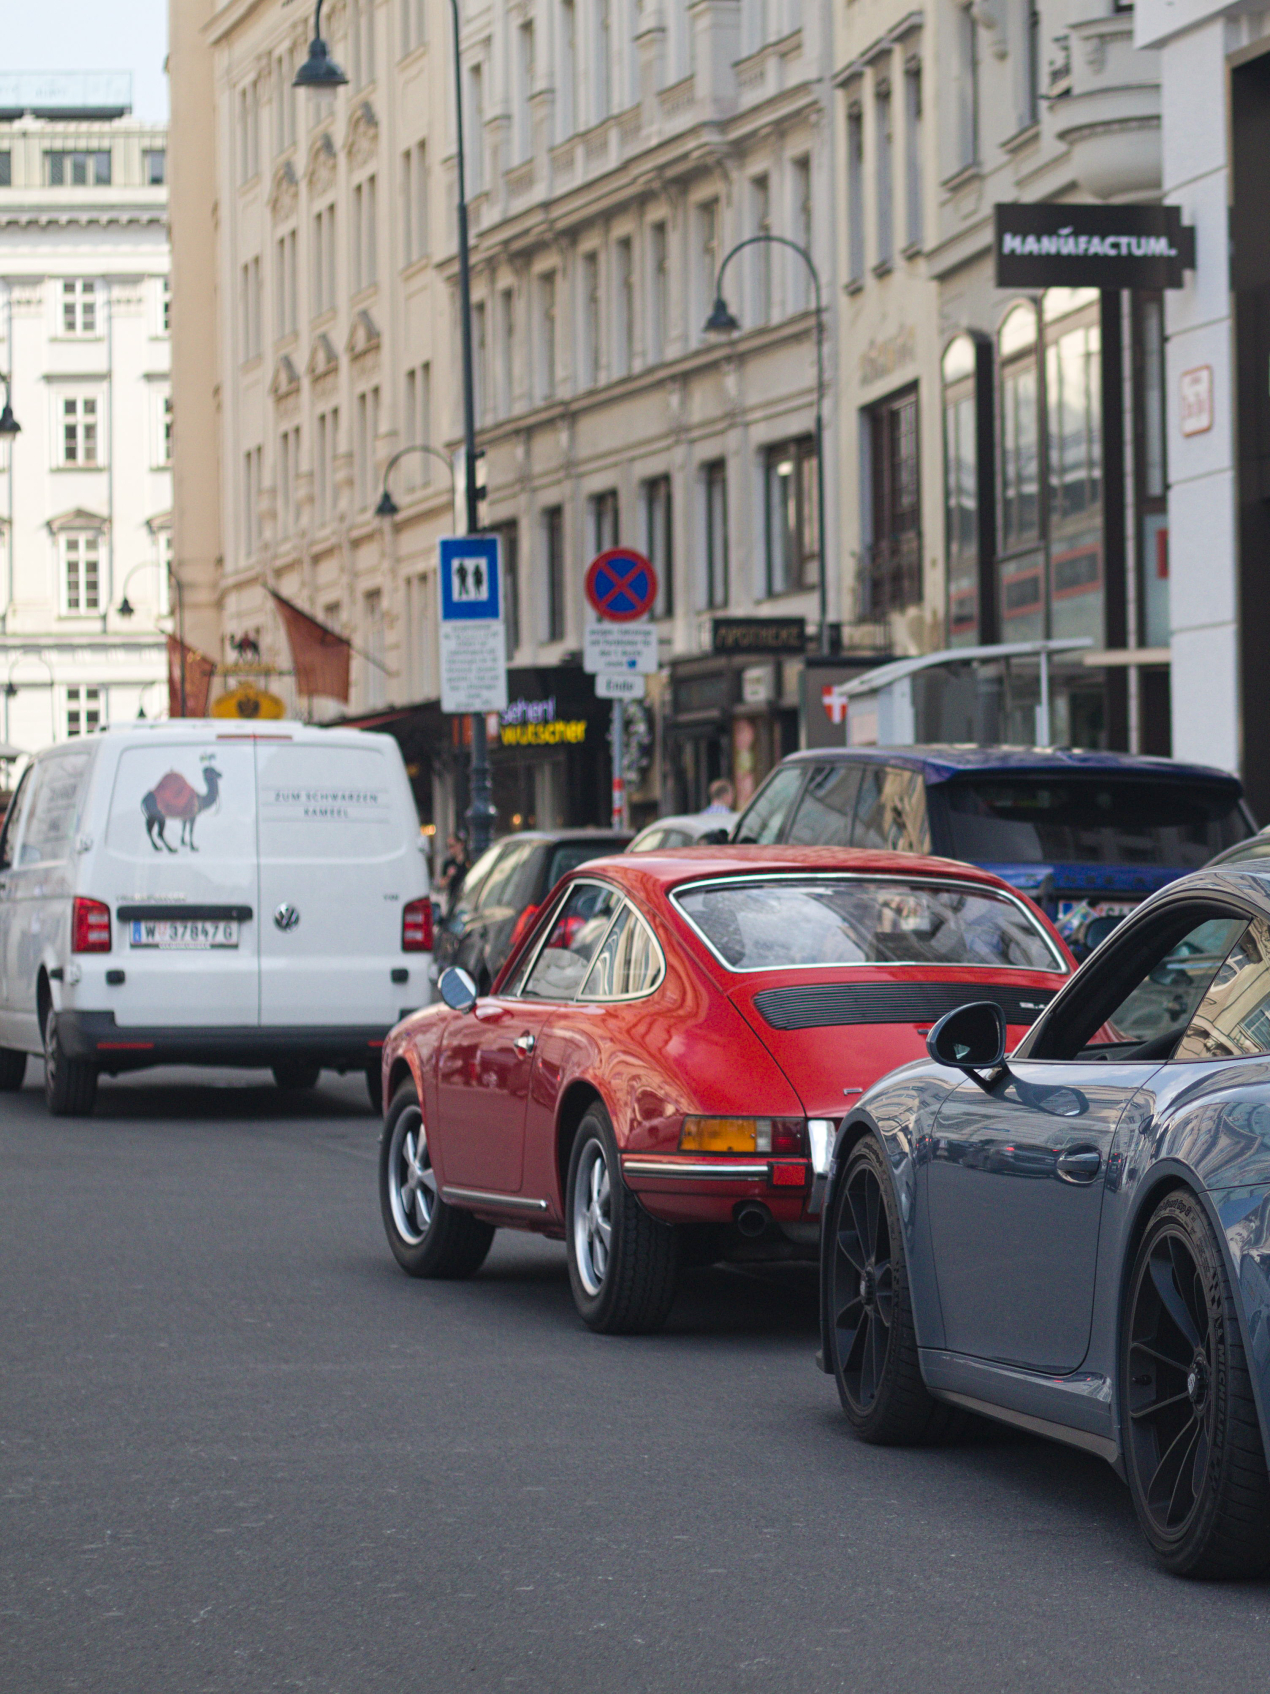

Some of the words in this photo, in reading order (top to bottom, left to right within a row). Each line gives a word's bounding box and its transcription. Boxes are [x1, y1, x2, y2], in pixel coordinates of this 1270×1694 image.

[275, 791, 301, 802] ZUM
[305, 791, 379, 803] SCHWARZEN
[303, 807, 349, 818] KAMEEL
